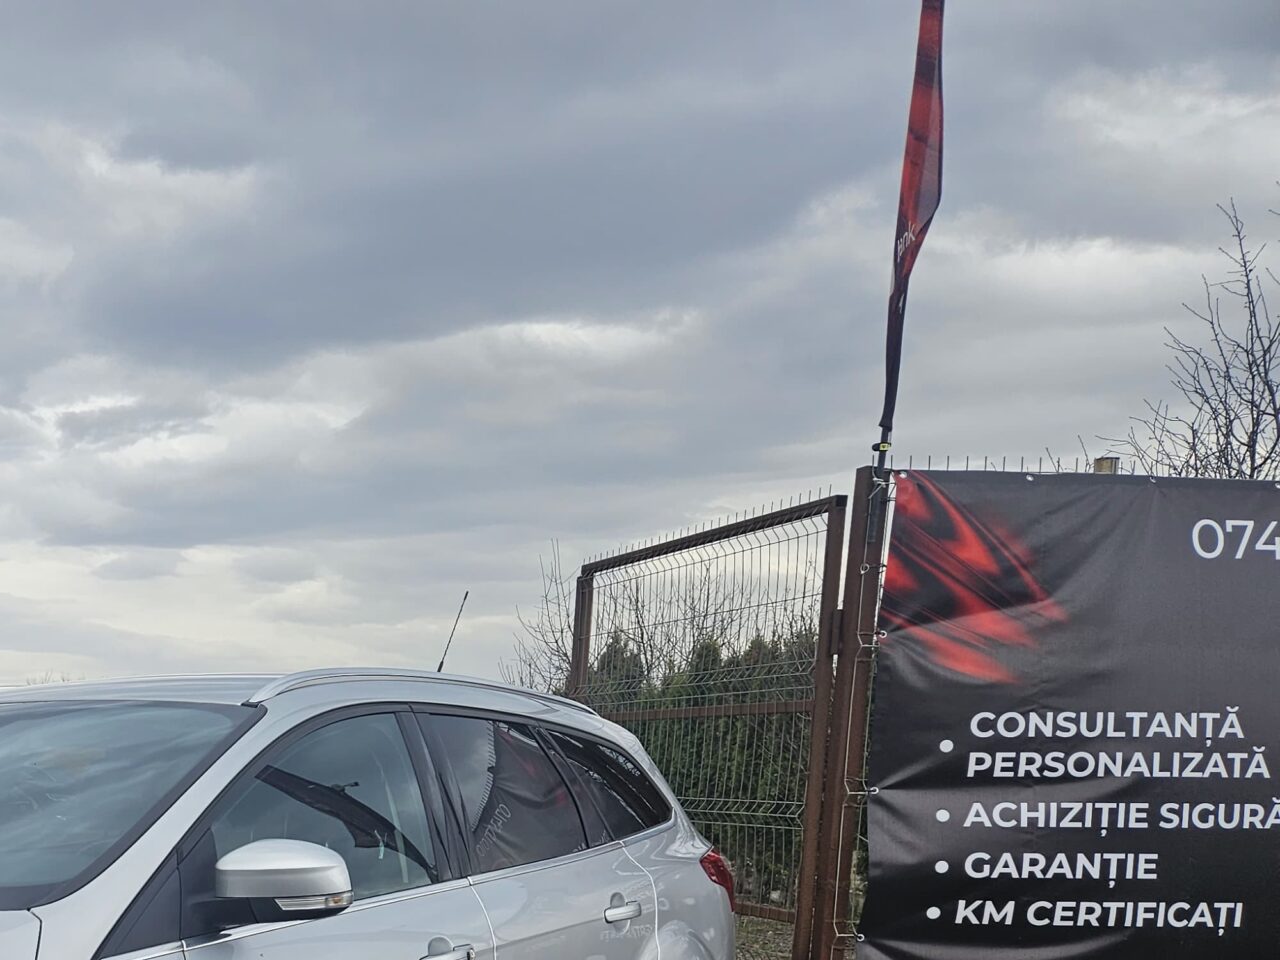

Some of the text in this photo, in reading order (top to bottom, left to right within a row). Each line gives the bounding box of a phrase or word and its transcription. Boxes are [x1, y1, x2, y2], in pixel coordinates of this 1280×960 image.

[1191, 518, 1280, 560] 074
[970, 706, 1245, 748] CONSULTANȚĂ
[966, 745, 1271, 779] PERSONALIZATĂ
[963, 796, 1280, 836] ACHIZIȚIE SIGURĂ
[964, 851, 1159, 888] GARANȚIE
[954, 899, 1244, 936] KM CERTIFICAȚI
